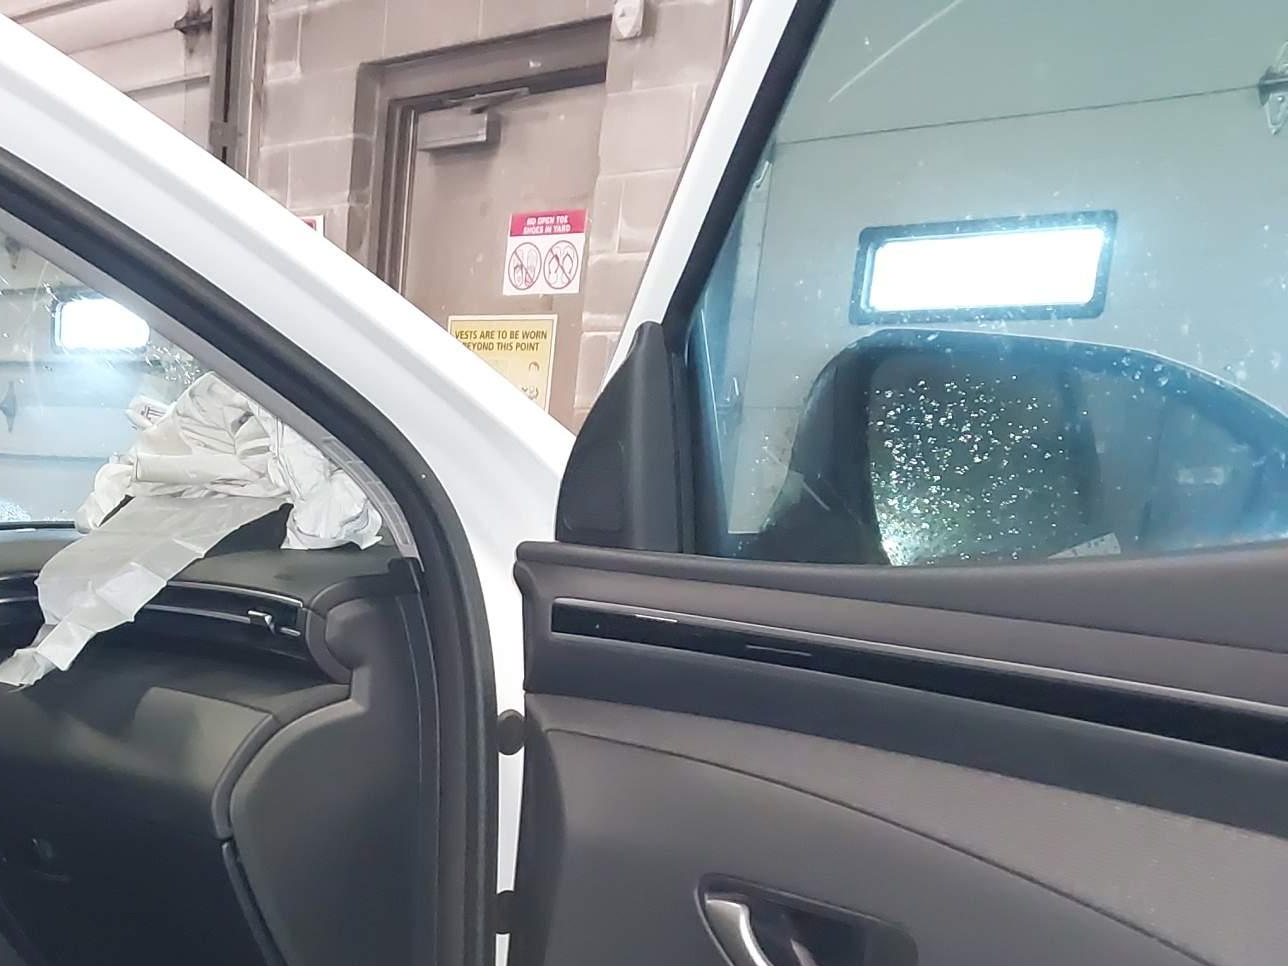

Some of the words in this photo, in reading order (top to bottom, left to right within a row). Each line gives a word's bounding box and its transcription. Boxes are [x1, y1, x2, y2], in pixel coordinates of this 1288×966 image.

[537, 216, 555, 225] OPEN
[553, 224, 571, 233] YARD
[455, 330, 478, 340] VESTS
[479, 330, 495, 340] ARE
[497, 330, 508, 340] TO
[509, 330, 520, 340] BE
[521, 330, 547, 340] WORN
[496, 341, 513, 351] THIS
[515, 341, 540, 351] POINT
